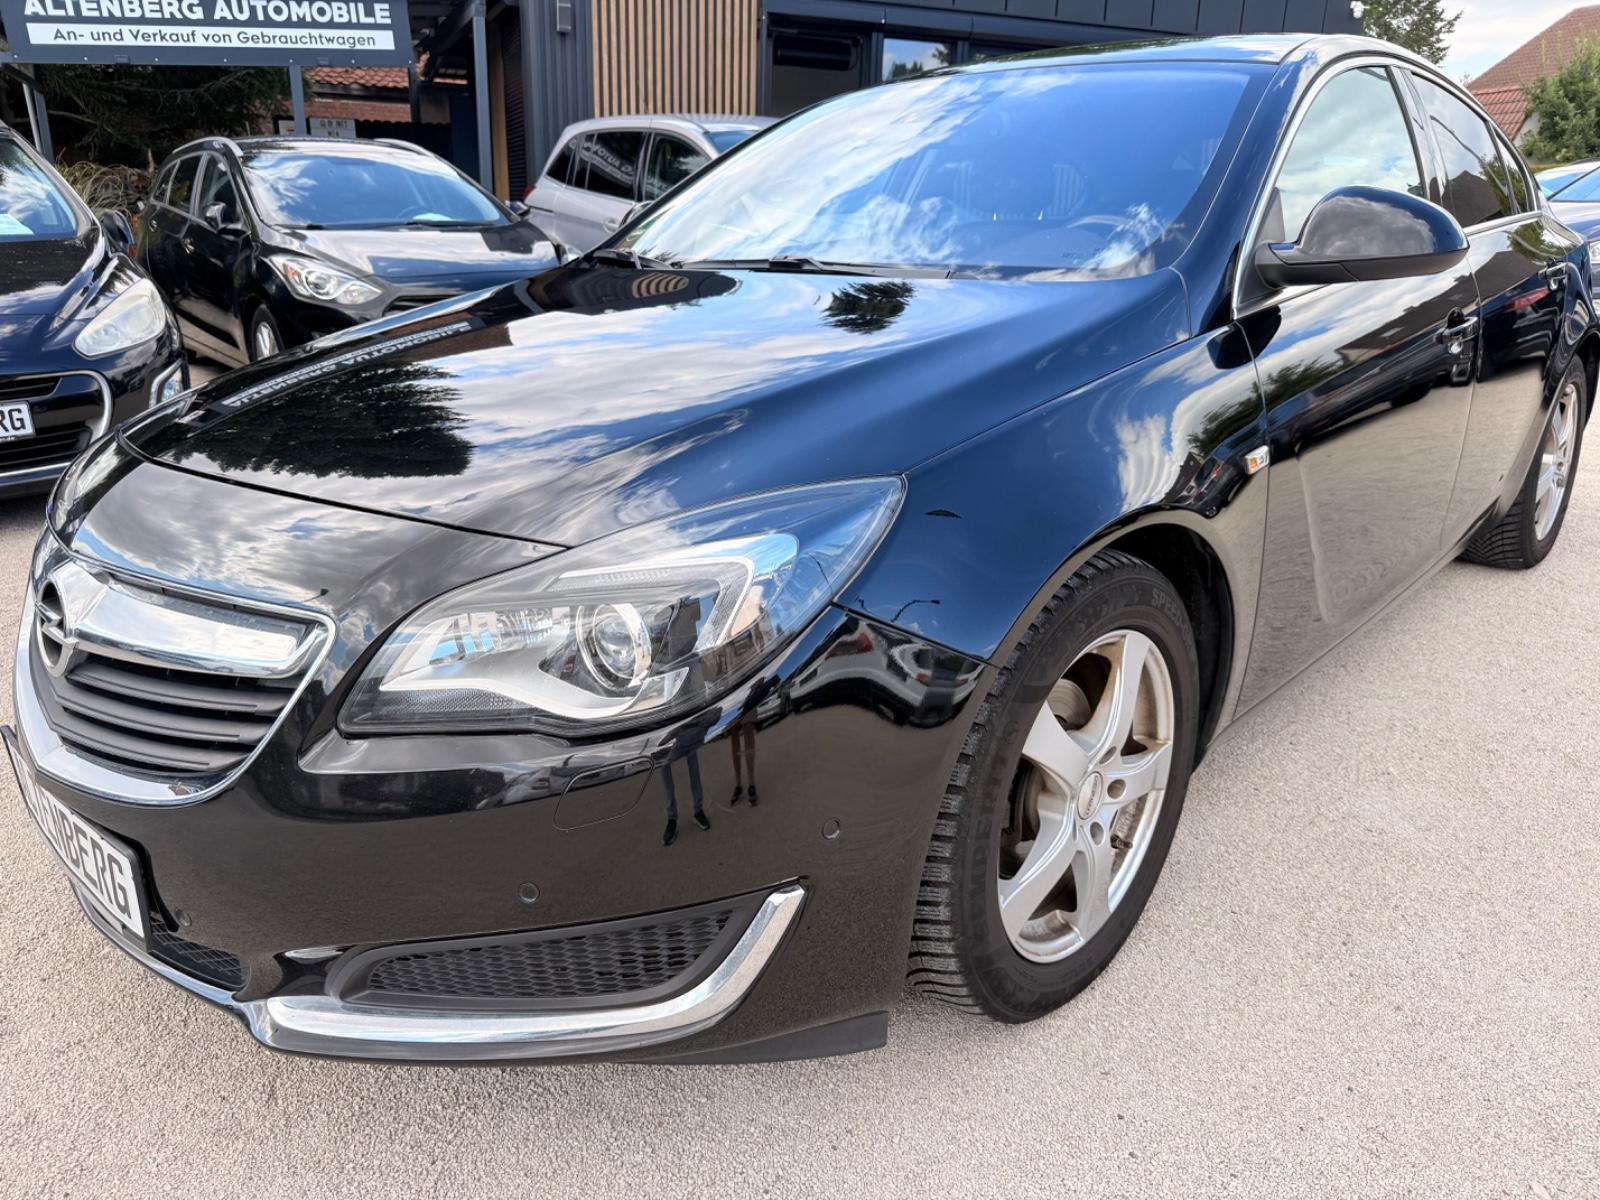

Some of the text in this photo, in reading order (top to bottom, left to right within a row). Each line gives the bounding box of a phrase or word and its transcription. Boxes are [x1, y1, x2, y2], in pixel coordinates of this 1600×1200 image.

[24, 0, 392, 24] ALTENBERG AUTOMOBILE
[53, 28, 376, 48] An- und Verkauf von Gebrauchtwagen
